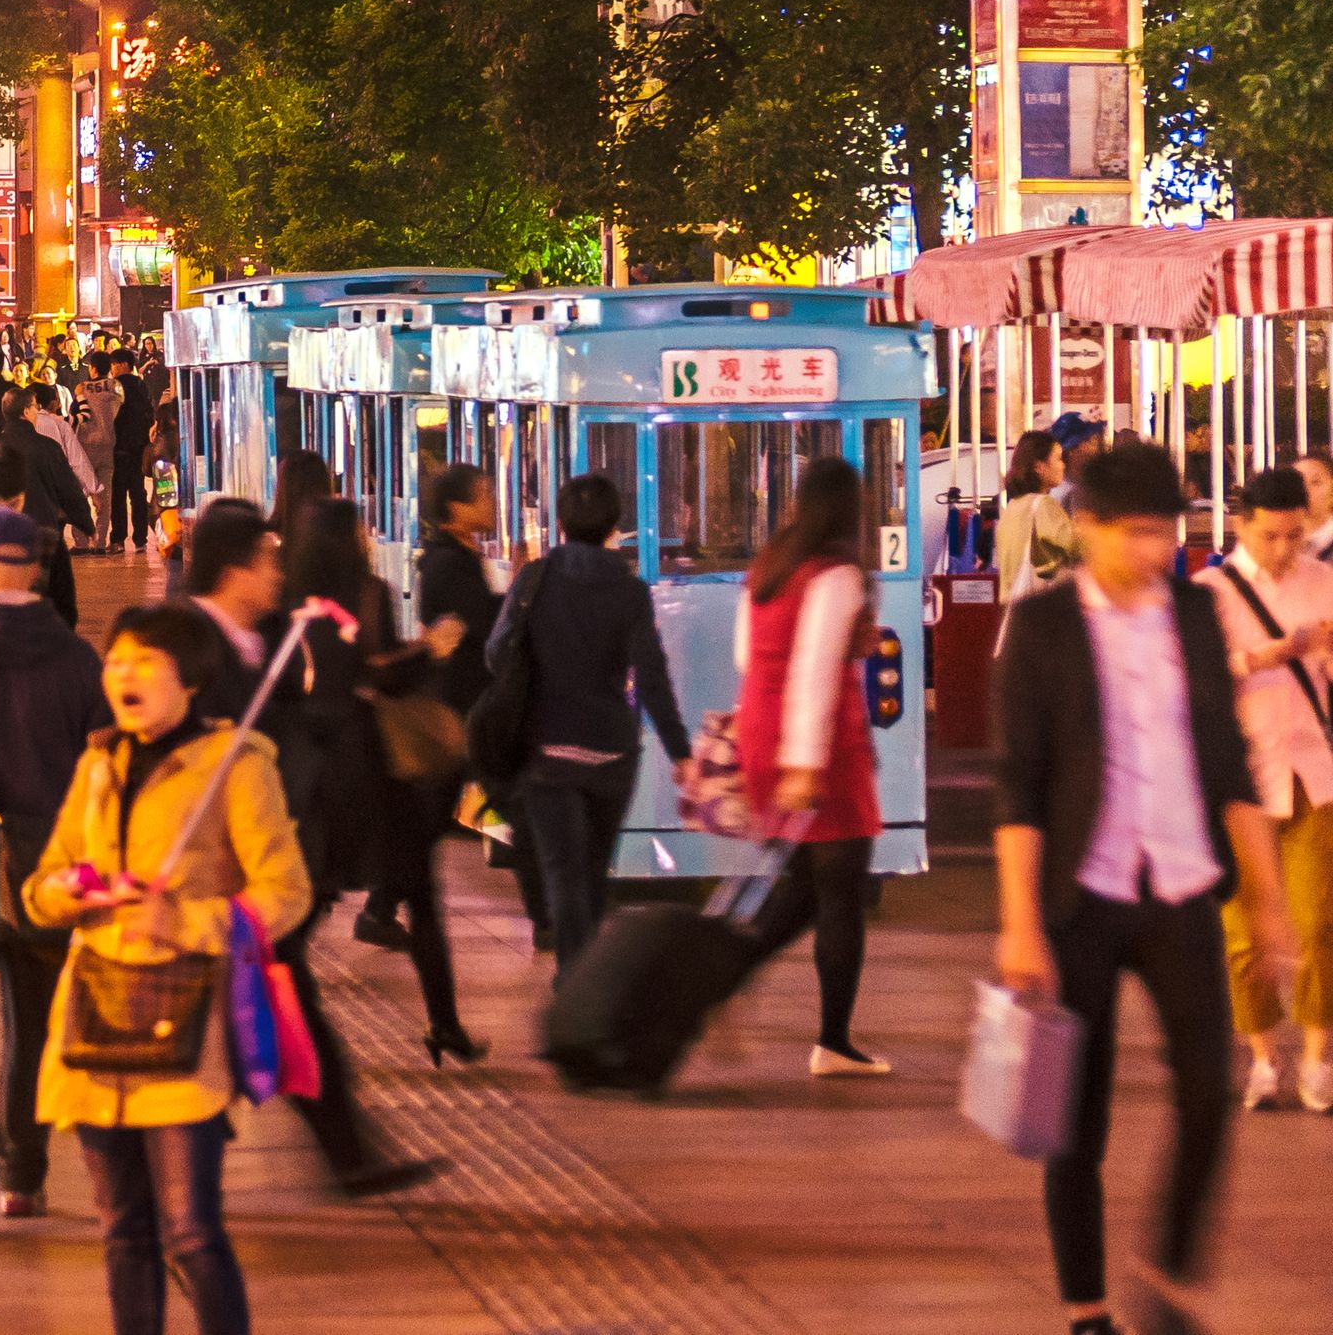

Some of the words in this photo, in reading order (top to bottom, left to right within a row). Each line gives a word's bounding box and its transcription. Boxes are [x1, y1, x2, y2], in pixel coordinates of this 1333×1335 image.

[718, 356, 824, 382] 观光车
[709, 385, 737, 398] City
[747, 384, 824, 398] Sightseeing
[888, 532, 901, 566] 2
